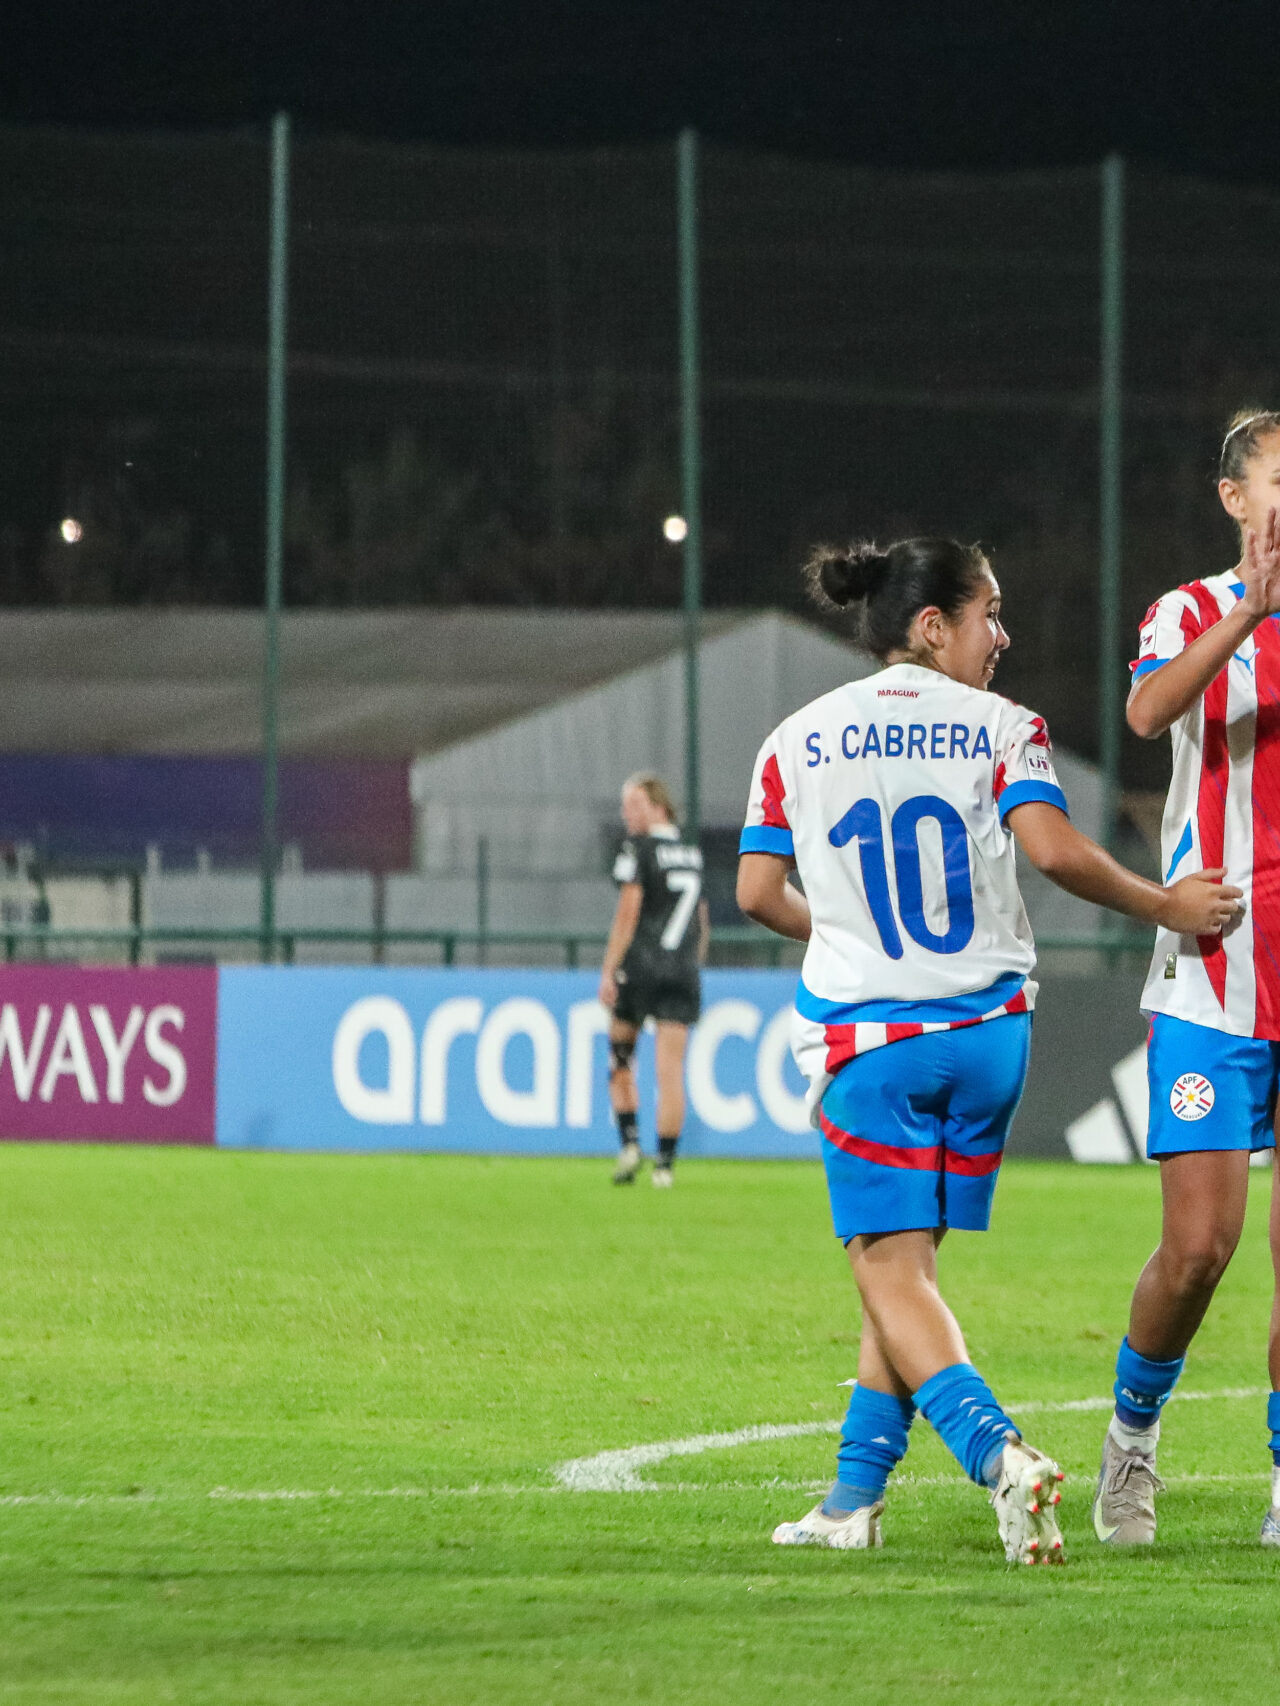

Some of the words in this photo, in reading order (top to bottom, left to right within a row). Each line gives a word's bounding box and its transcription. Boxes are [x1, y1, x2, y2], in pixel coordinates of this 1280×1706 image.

[877, 689, 919, 698] PARAGUAY
[806, 732, 830, 767] S.
[842, 723, 992, 760] CABRERA
[828, 795, 975, 960] 10
[660, 870, 701, 950] 7
